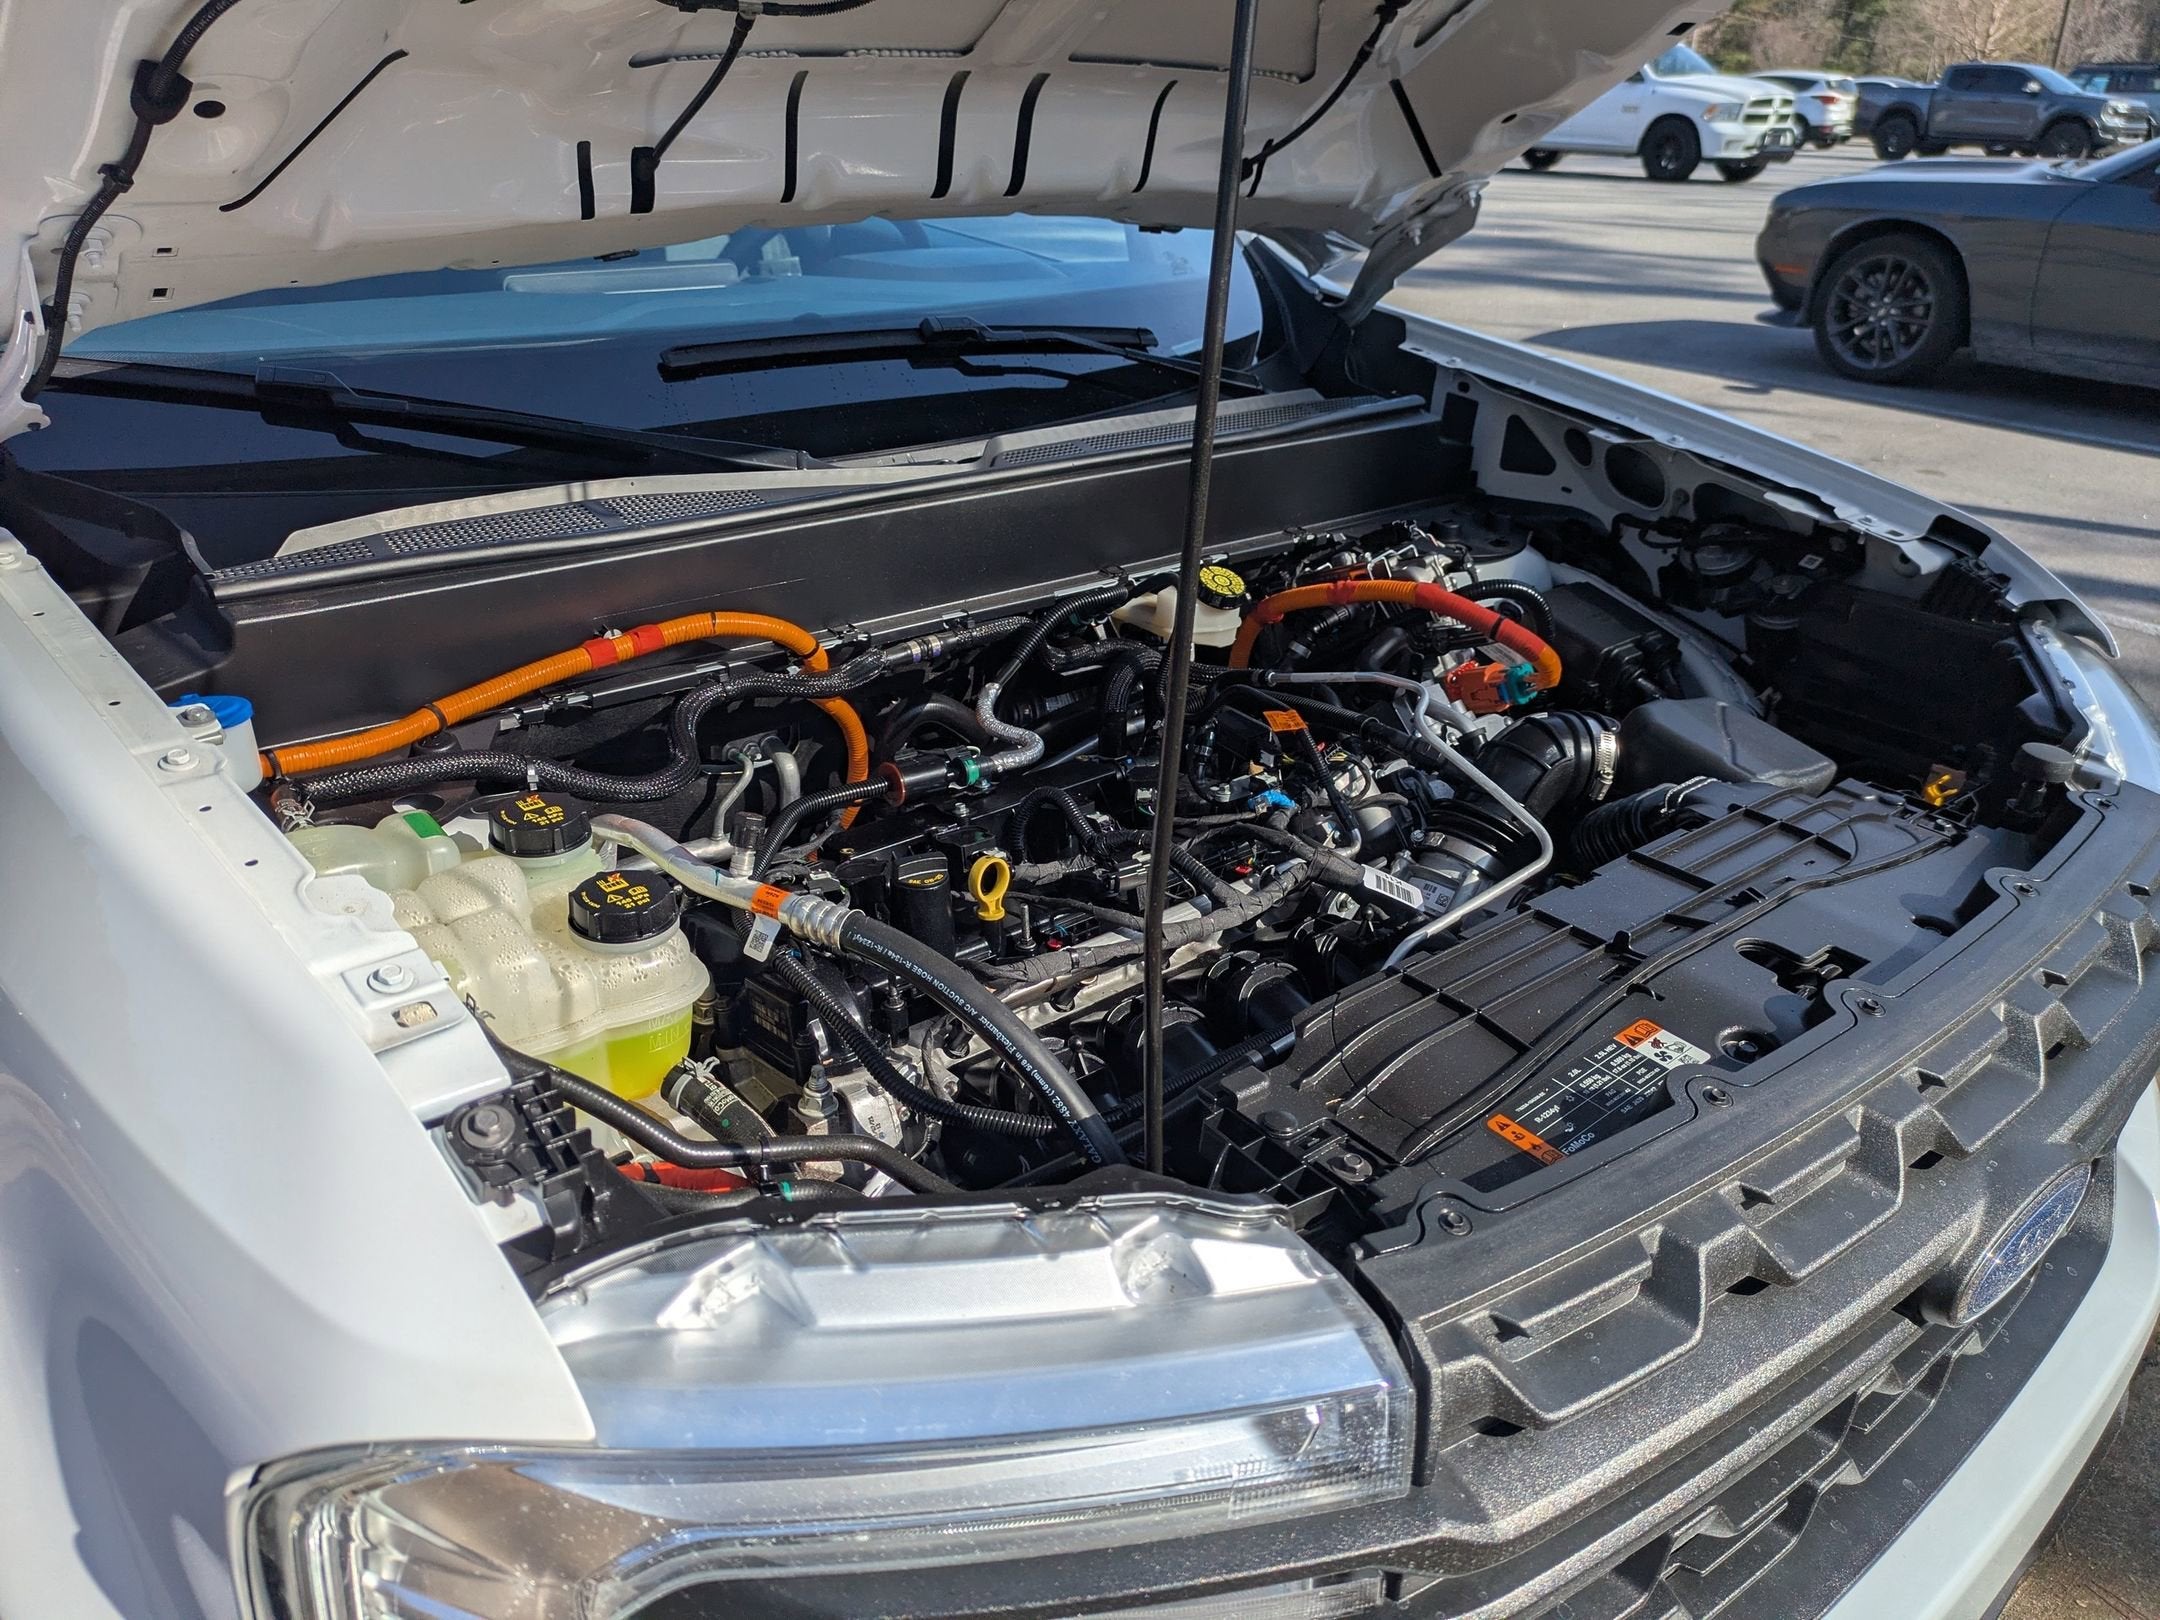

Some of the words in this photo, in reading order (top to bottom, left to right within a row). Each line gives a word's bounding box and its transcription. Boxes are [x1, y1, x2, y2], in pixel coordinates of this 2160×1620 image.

[888, 950, 912, 968] R-134a
[912, 965, 933, 982] HOSE
[933, 979, 964, 1005] SUCTION
[964, 1004, 978, 1015] A/C
[979, 1016, 1016, 1053] Flexbarrier
[1031, 1070, 1055, 1096] (16mm)
[1052, 1096, 1070, 1116] 4882
[1067, 1115, 1101, 1163] GALAXY
[1561, 1132, 1595, 1156] FoMoCo
